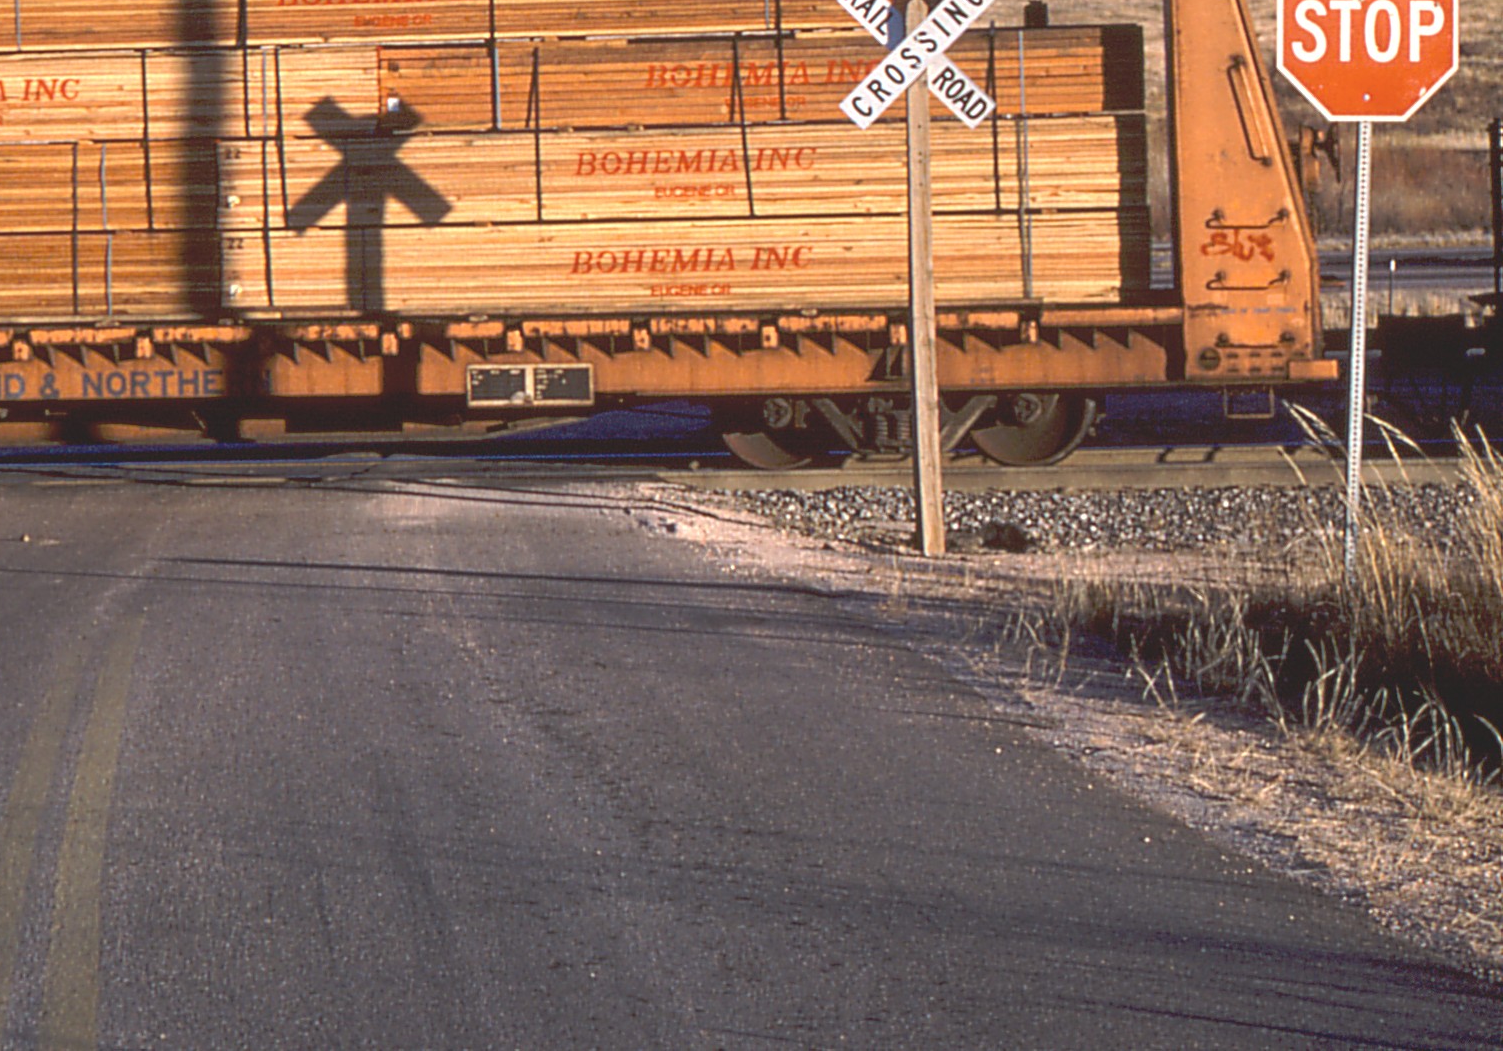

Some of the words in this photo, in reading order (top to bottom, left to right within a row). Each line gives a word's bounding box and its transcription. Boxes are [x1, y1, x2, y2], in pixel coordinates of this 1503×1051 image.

[23, 78, 80, 101] INC
[932, 66, 987, 120] ROAD
[576, 149, 740, 176] BOHEMIA
[752, 147, 818, 171] INC
[654, 185, 711, 198] EUGENE
[571, 248, 735, 274] BOHEMIA
[750, 246, 813, 271] INC
[650, 284, 707, 297] EUGENE
[40, 372, 59, 398] &
